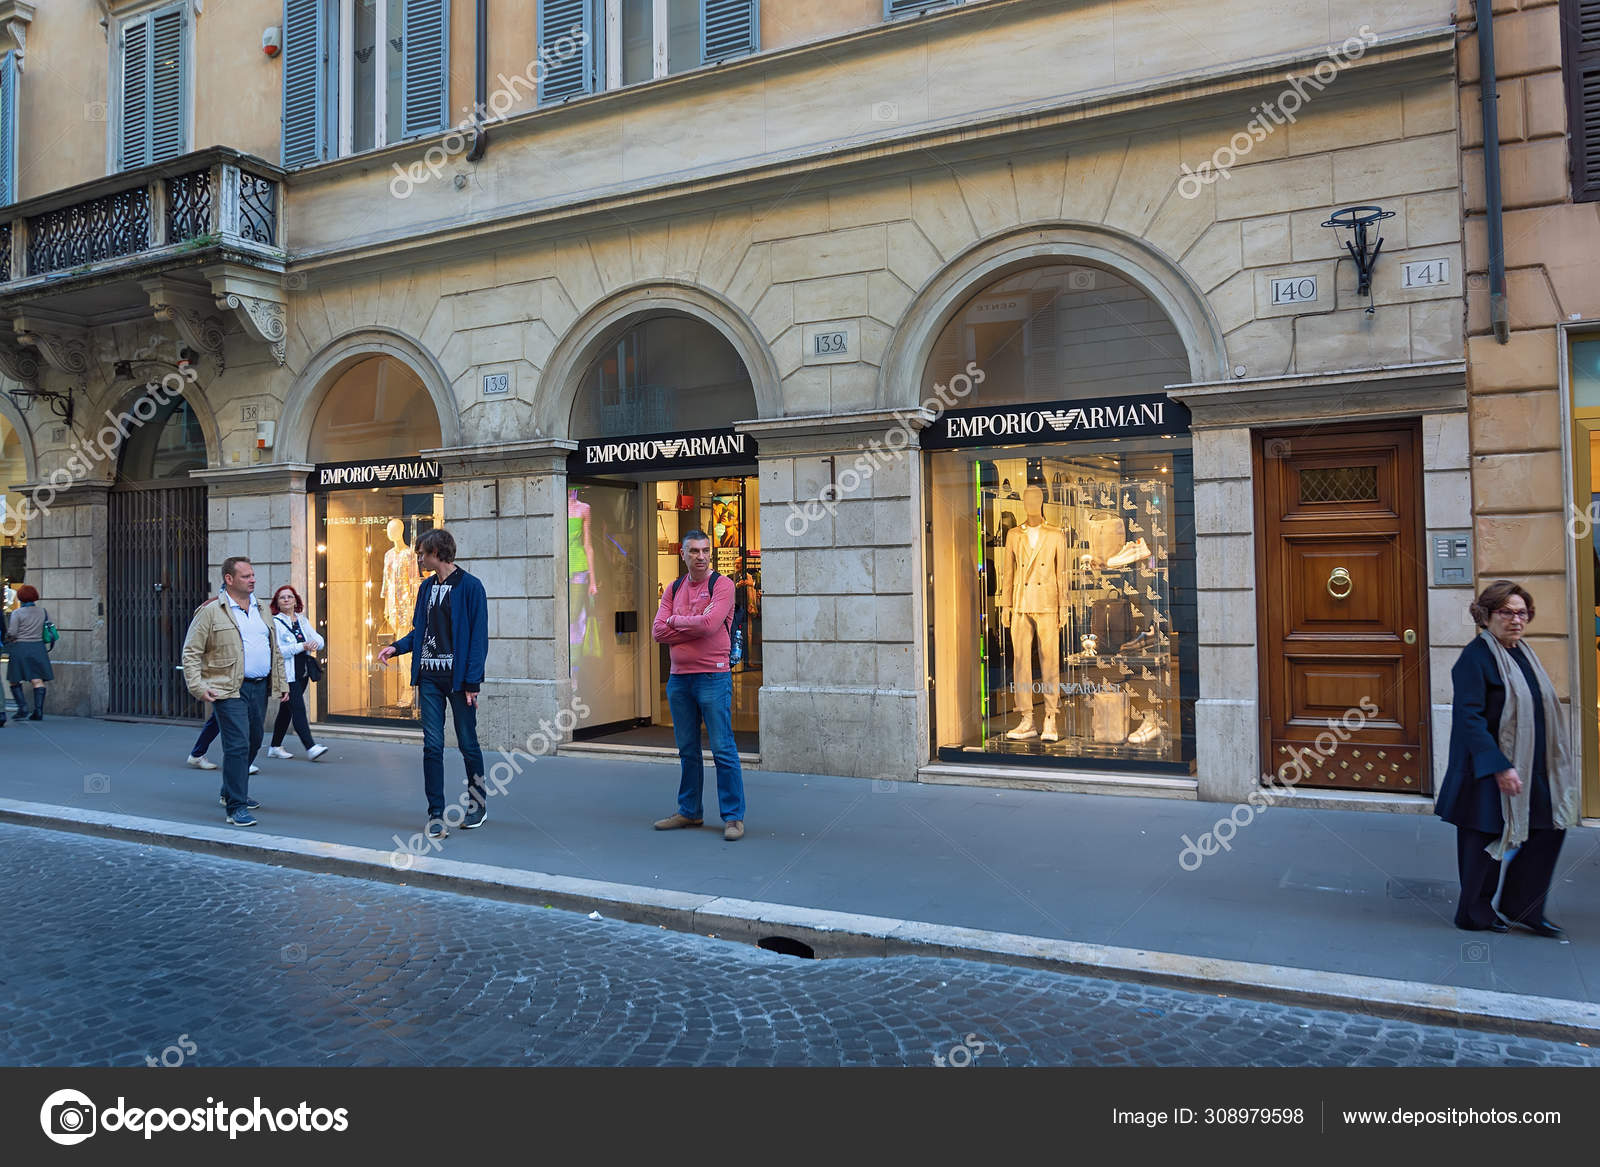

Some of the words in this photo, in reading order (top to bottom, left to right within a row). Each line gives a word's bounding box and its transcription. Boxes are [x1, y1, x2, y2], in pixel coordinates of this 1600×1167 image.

[1405, 262, 1444, 286] 141
[1273, 279, 1315, 302] 140
[485, 376, 507, 392] 139
[242, 407, 257, 421] 138
[946, 411, 1044, 438] EMPORIO
[1074, 403, 1165, 430] ARMANI
[586, 440, 657, 464] EMPORIO
[678, 434, 745, 457] ARMANI
[320, 465, 374, 485] EMPORIO
[390, 461, 439, 480] ARMANI
